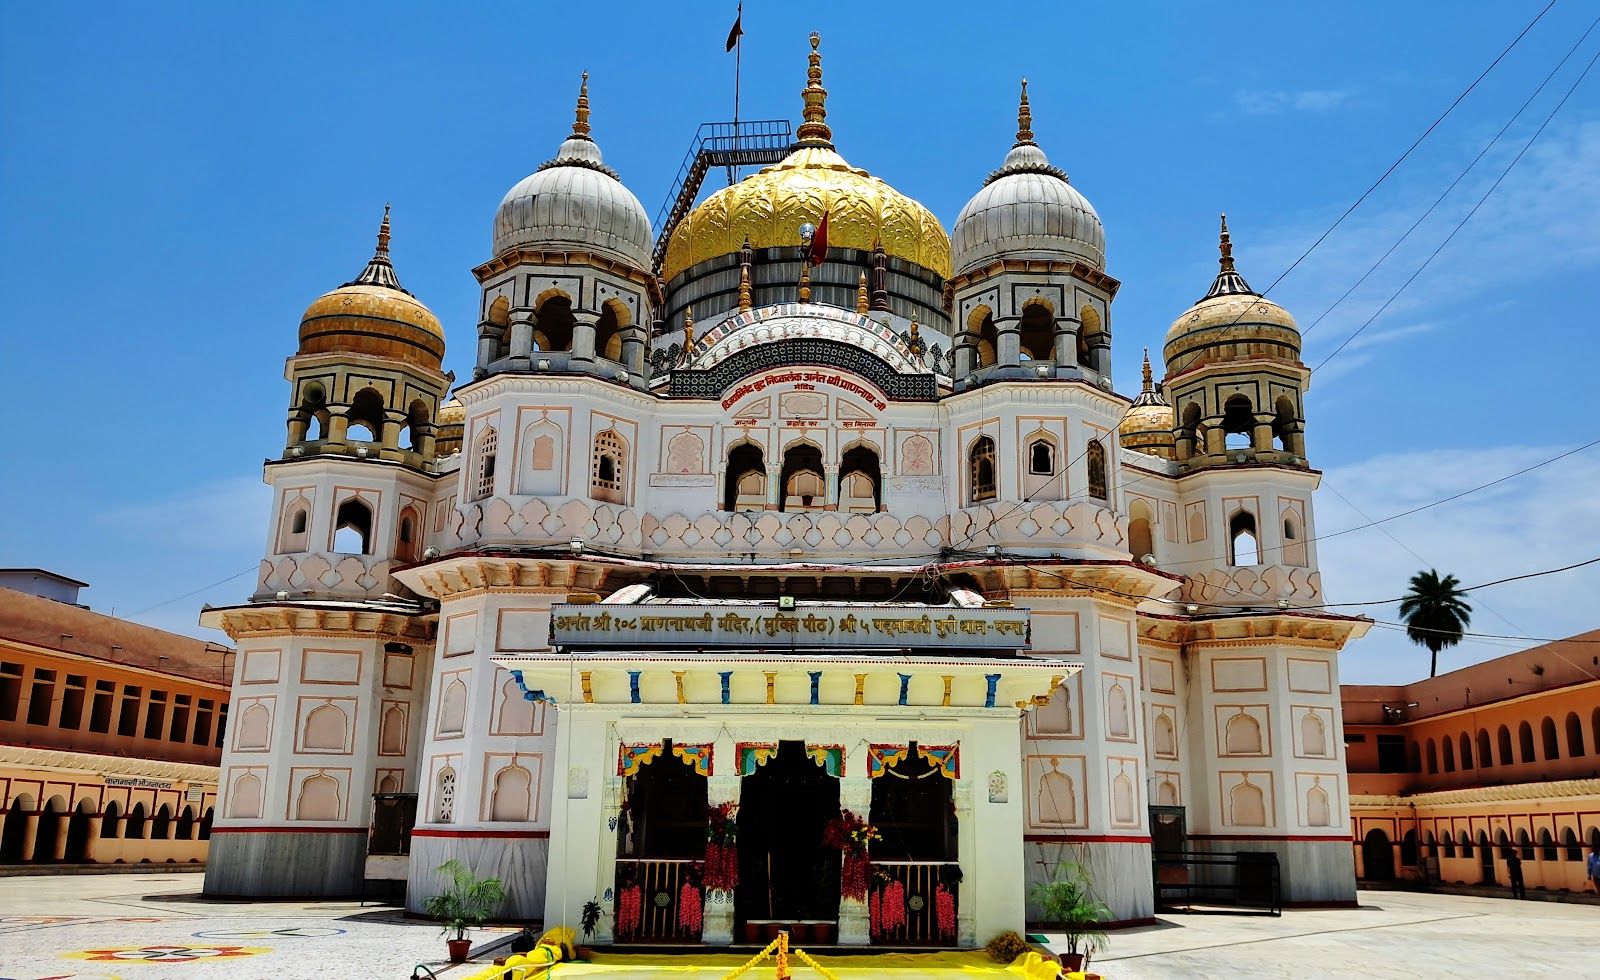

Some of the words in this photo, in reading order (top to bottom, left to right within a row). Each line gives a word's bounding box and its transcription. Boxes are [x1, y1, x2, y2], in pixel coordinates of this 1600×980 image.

[803, 371, 828, 383] अनंत
[839, 379, 876, 403] प्राणनाथ
[874, 399, 887, 411] जी
[556, 611, 591, 631] अनंत
[592, 610, 612, 631] श्री
[614, 617, 638, 631] १०८
[639, 611, 714, 632] प्राणनाथजी
[839, 613, 857, 633] श्री
[860, 618, 870, 634] ५
[934, 613, 958, 639] पुरी
